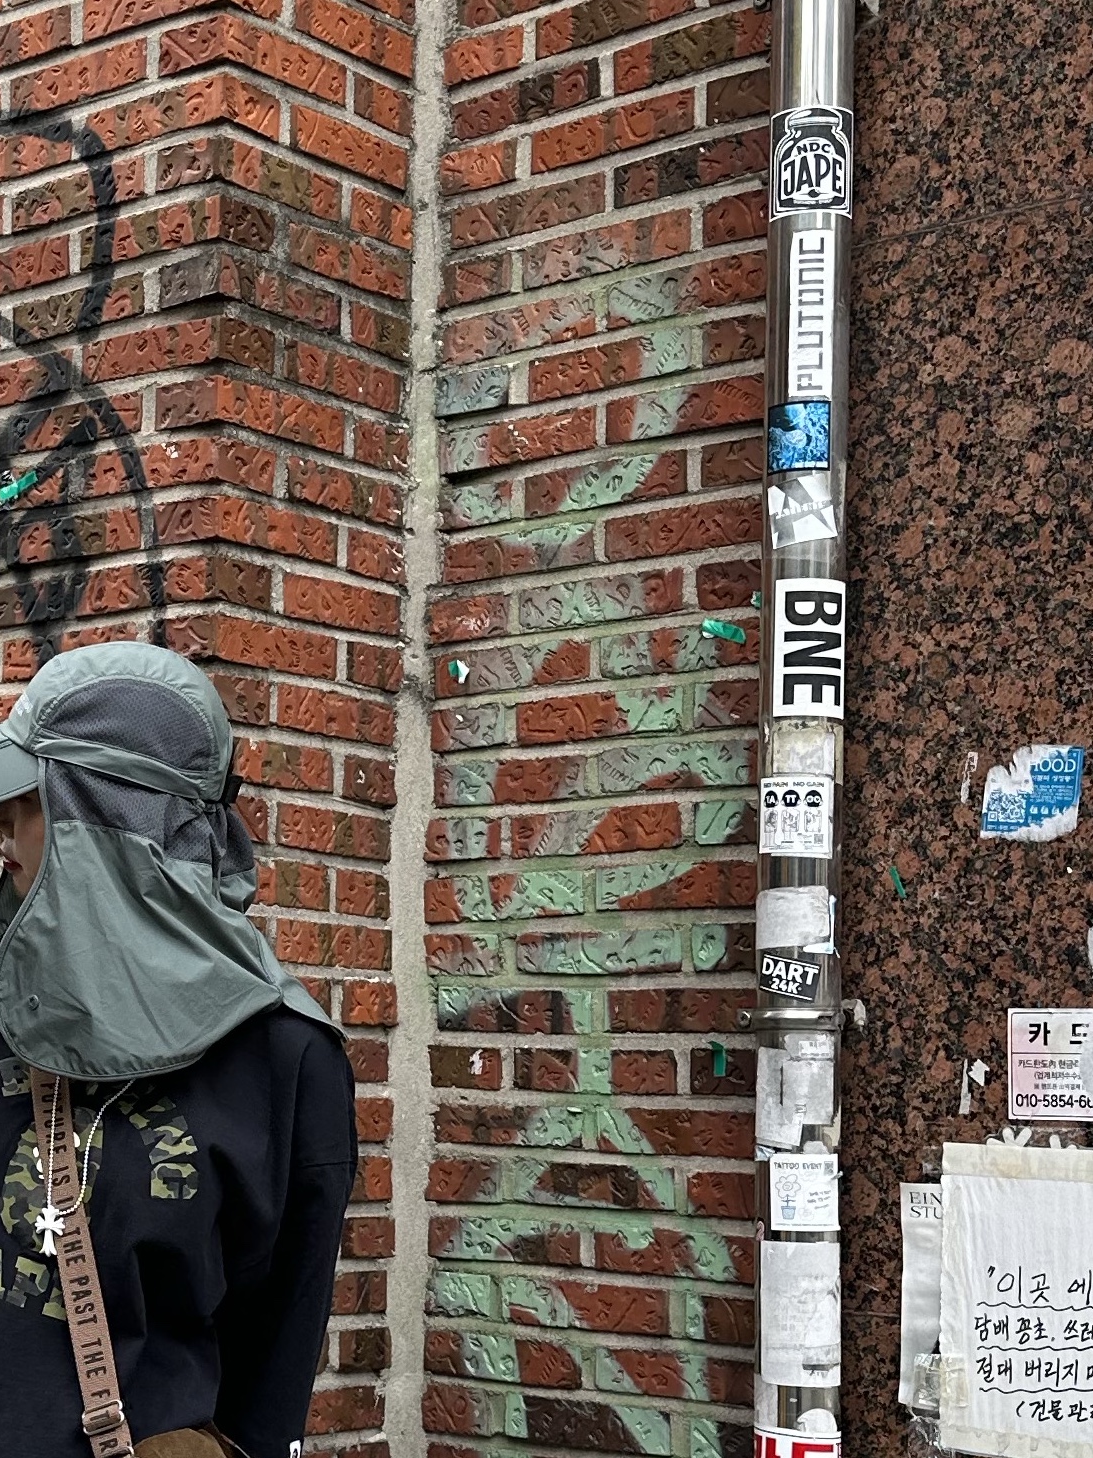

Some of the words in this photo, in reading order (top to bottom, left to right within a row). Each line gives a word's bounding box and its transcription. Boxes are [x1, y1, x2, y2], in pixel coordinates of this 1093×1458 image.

[796, 142, 831, 155] NDC
[783, 153, 843, 197] JAPE
[796, 237, 825, 392] PLUTONIC
[782, 590, 843, 707] BNE
[762, 957, 819, 986] DART
[52, 1165, 71, 1187] IS
[62, 1226, 87, 1267] THE
[69, 1275, 98, 1324] PAST
[974, 1312, 1010, 1342] 담배
[80, 1336, 108, 1378] THE
[975, 1353, 1013, 1384] 절대
[1024, 1356, 1079, 1388] 버리지
